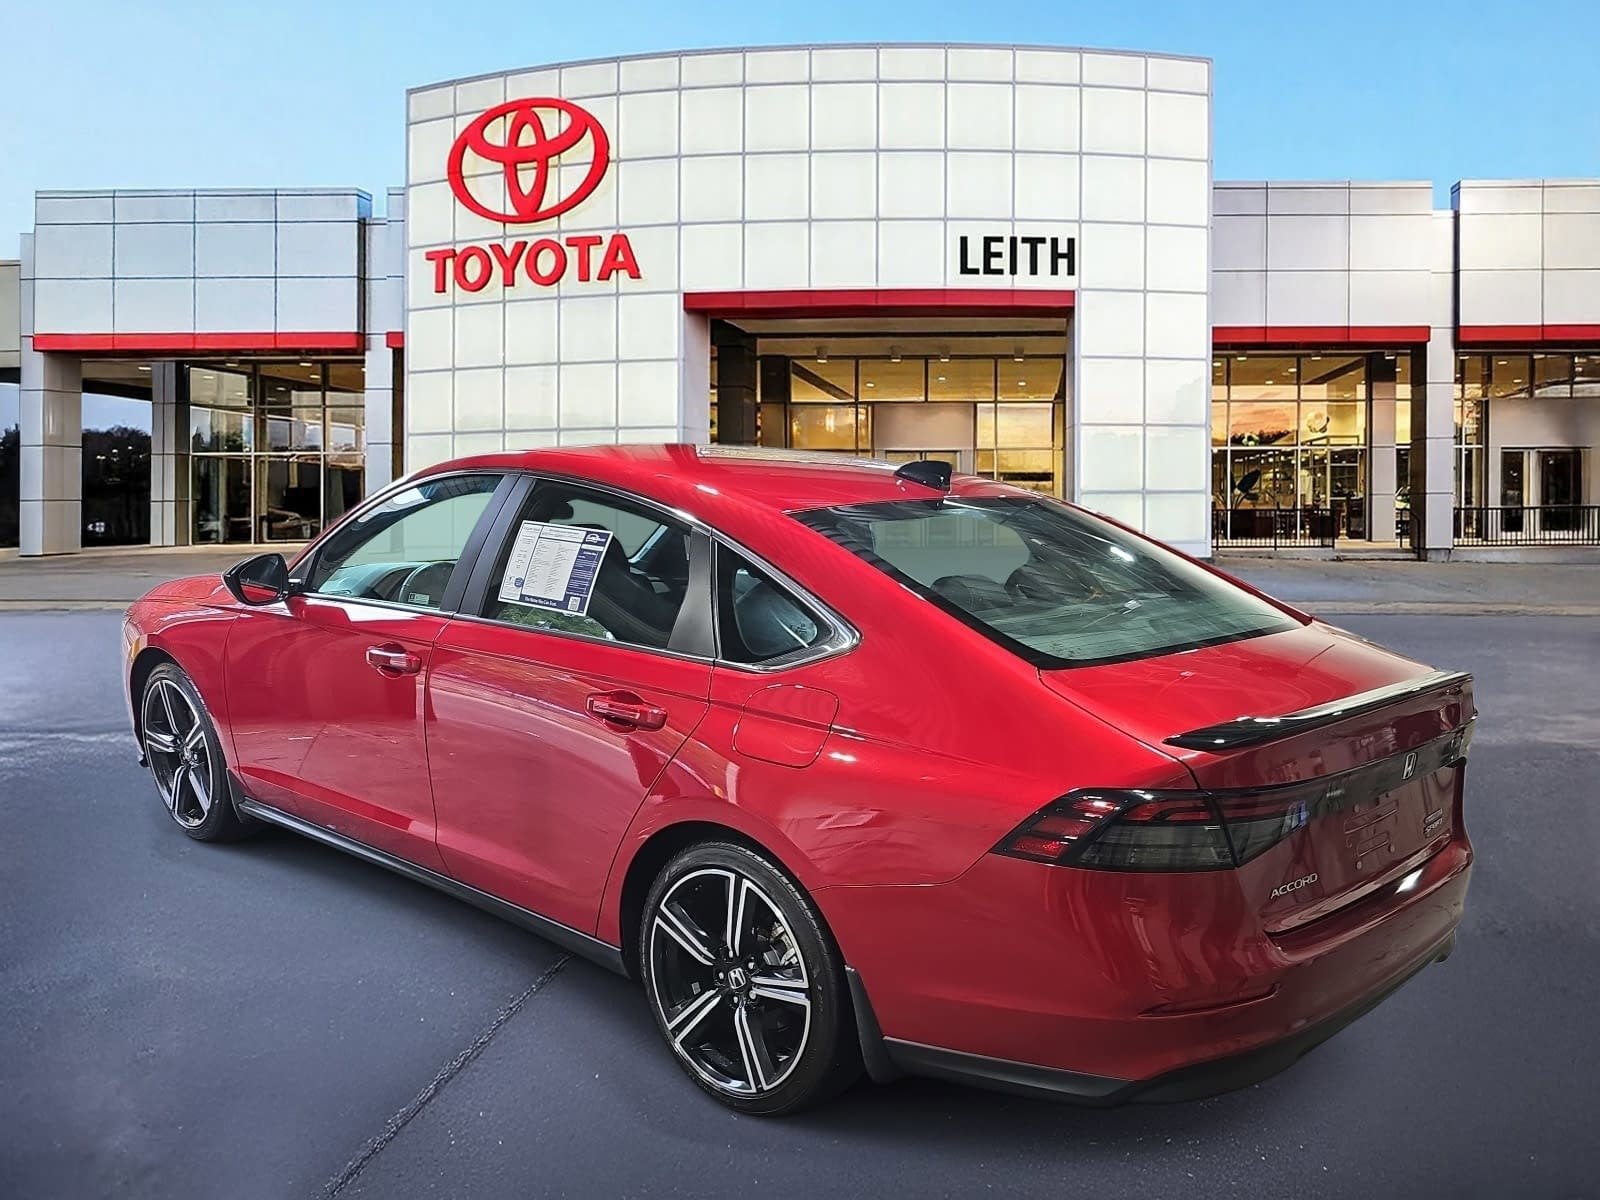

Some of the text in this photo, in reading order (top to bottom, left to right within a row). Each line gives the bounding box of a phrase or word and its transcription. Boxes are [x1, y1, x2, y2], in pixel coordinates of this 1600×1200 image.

[425, 232, 642, 293] TOYOTA
[960, 236, 1076, 276] LEITH
[1270, 873, 1318, 900] ACCORD
